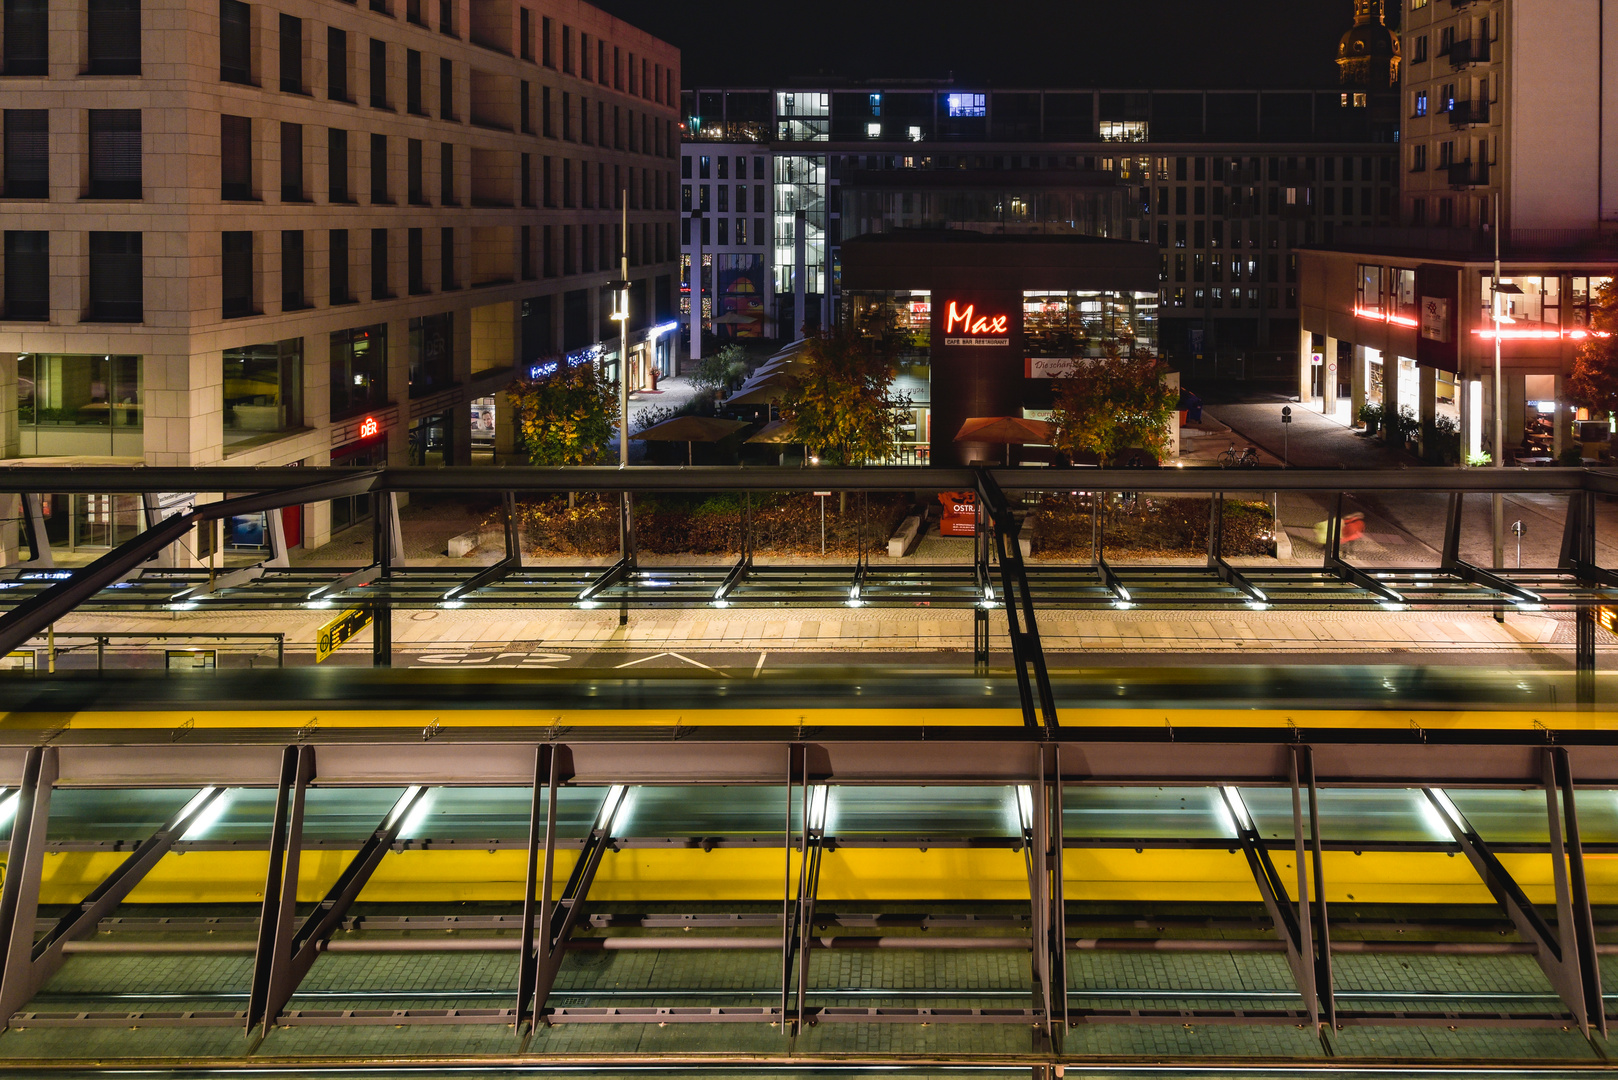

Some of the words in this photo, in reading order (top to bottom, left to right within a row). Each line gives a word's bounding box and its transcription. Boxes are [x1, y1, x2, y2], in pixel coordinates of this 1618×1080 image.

[946, 301, 1007, 334] Max
[1035, 360, 1049, 369] Die
[361, 420, 378, 438] DER
